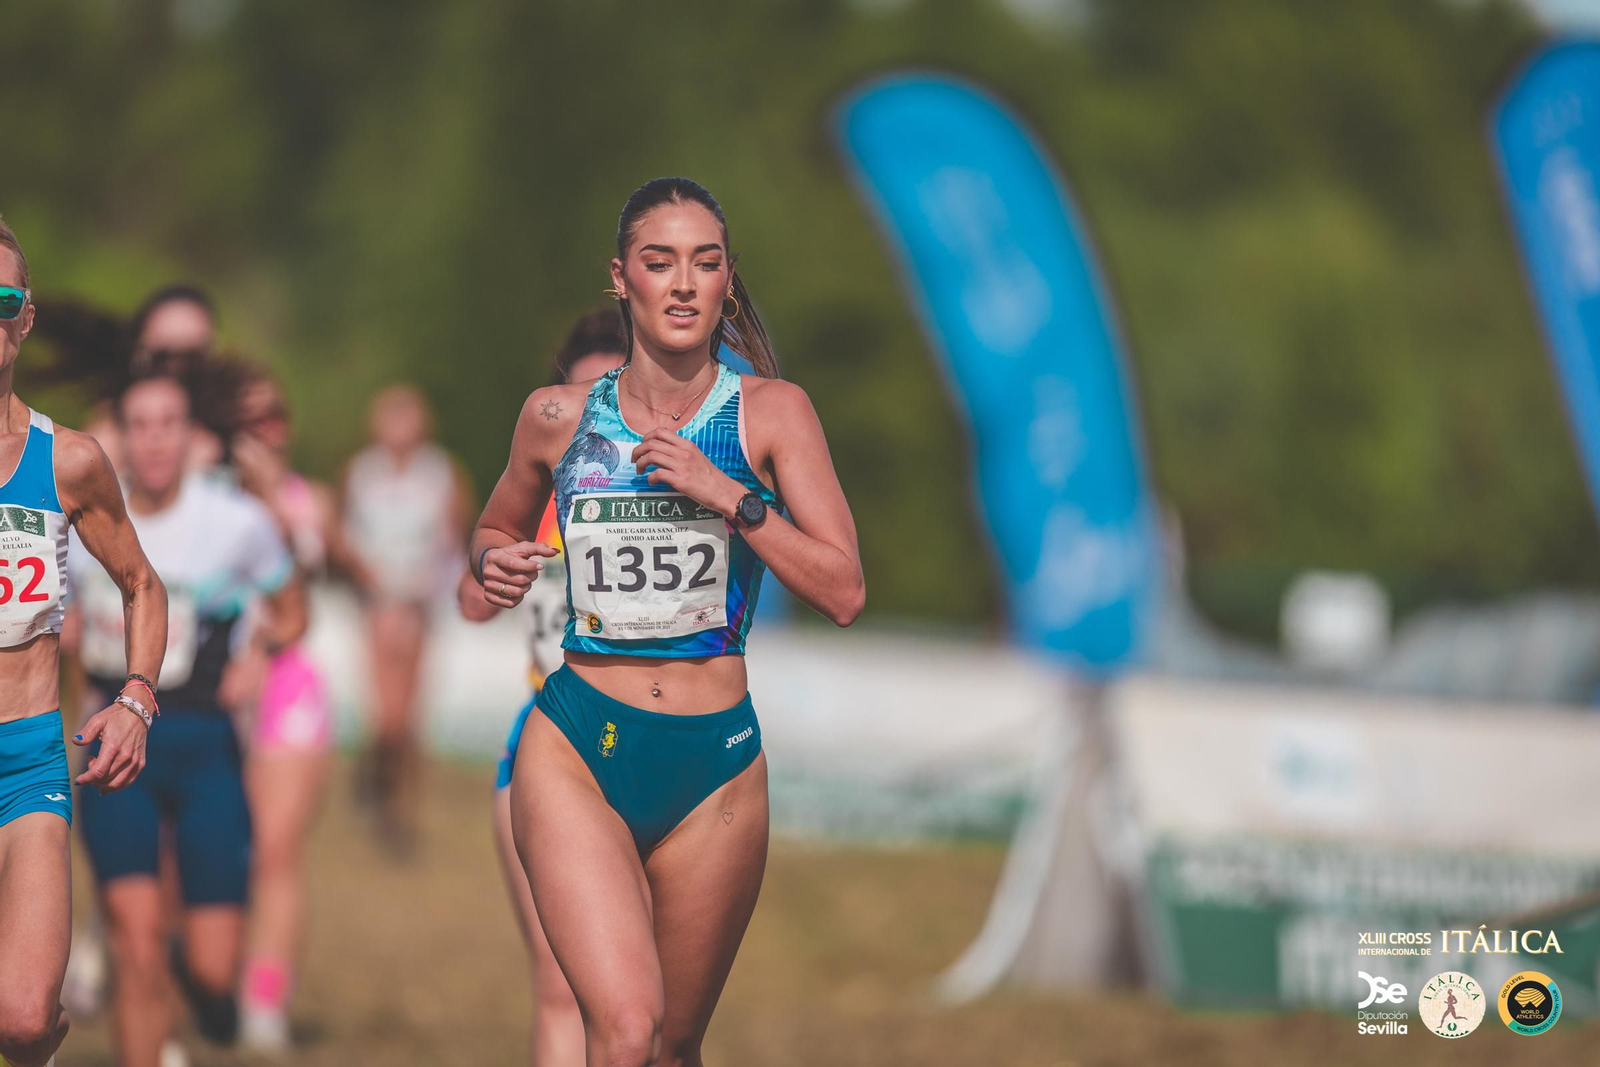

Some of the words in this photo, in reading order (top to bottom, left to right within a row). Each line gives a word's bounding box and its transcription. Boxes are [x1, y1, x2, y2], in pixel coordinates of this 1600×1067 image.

[577, 477, 612, 488] HORIZON
[611, 499, 683, 517] ITÁLICA
[585, 543, 717, 592] 1352
[725, 726, 753, 748] Joma
